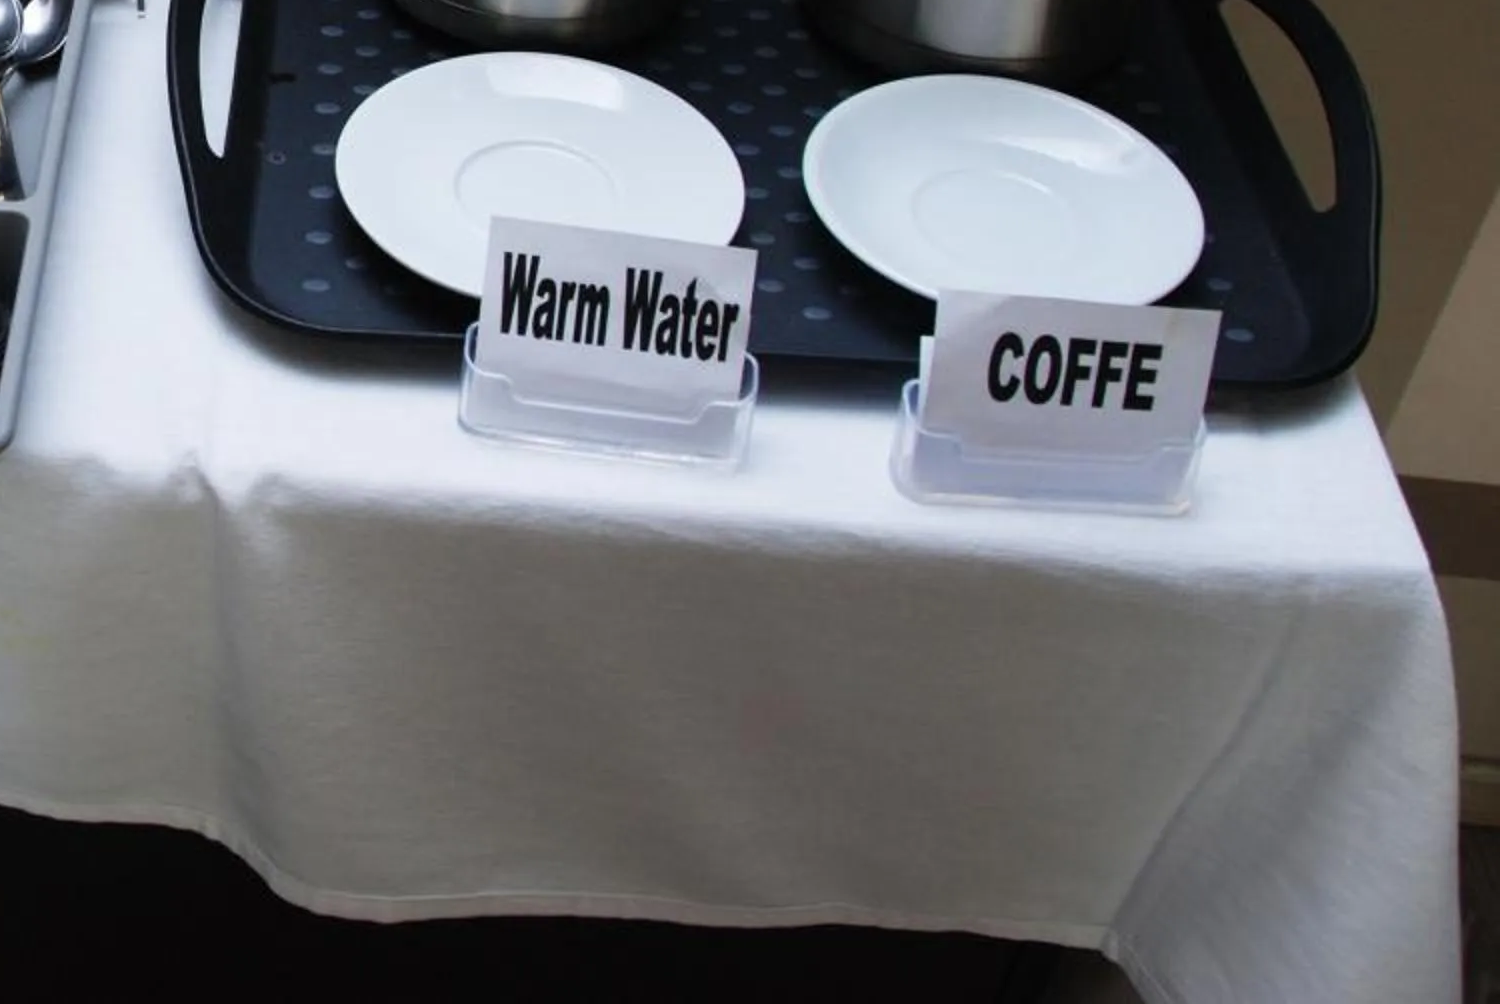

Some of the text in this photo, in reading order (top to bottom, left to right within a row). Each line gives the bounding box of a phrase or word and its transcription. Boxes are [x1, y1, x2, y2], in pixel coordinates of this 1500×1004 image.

[500, 251, 740, 363] Warm Water
[987, 331, 1163, 411] COFFE
